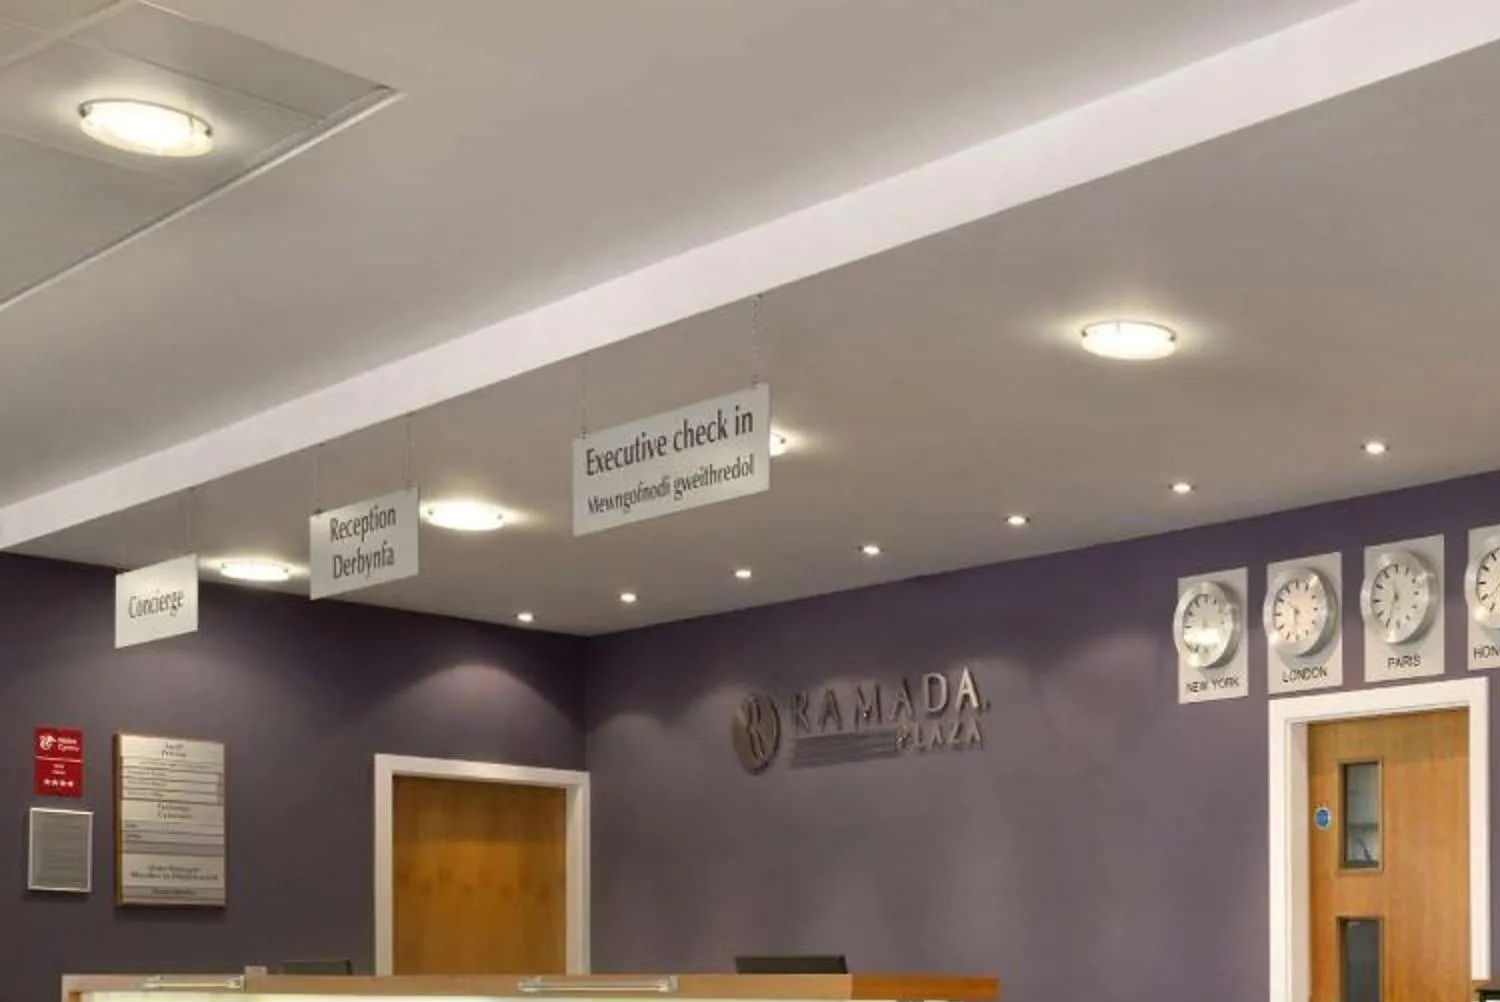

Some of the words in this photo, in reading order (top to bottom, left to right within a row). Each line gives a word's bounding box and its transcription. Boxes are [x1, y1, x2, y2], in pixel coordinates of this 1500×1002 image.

[585, 431, 667, 476] Executive
[673, 409, 728, 452] check
[735, 405, 753, 437] in
[673, 453, 754, 500] gweithredol
[329, 504, 397, 542] Reception
[333, 540, 395, 579] Derbynfa
[128, 590, 184, 618] Concierge
[1281, 666, 1328, 683] LONDON
[1387, 653, 1421, 669] PARIS
[791, 666, 981, 735] RAMADA
[1186, 680, 1208, 693] NEW
[1212, 676, 1240, 689] YORK
[896, 713, 985, 751] PLAZA
